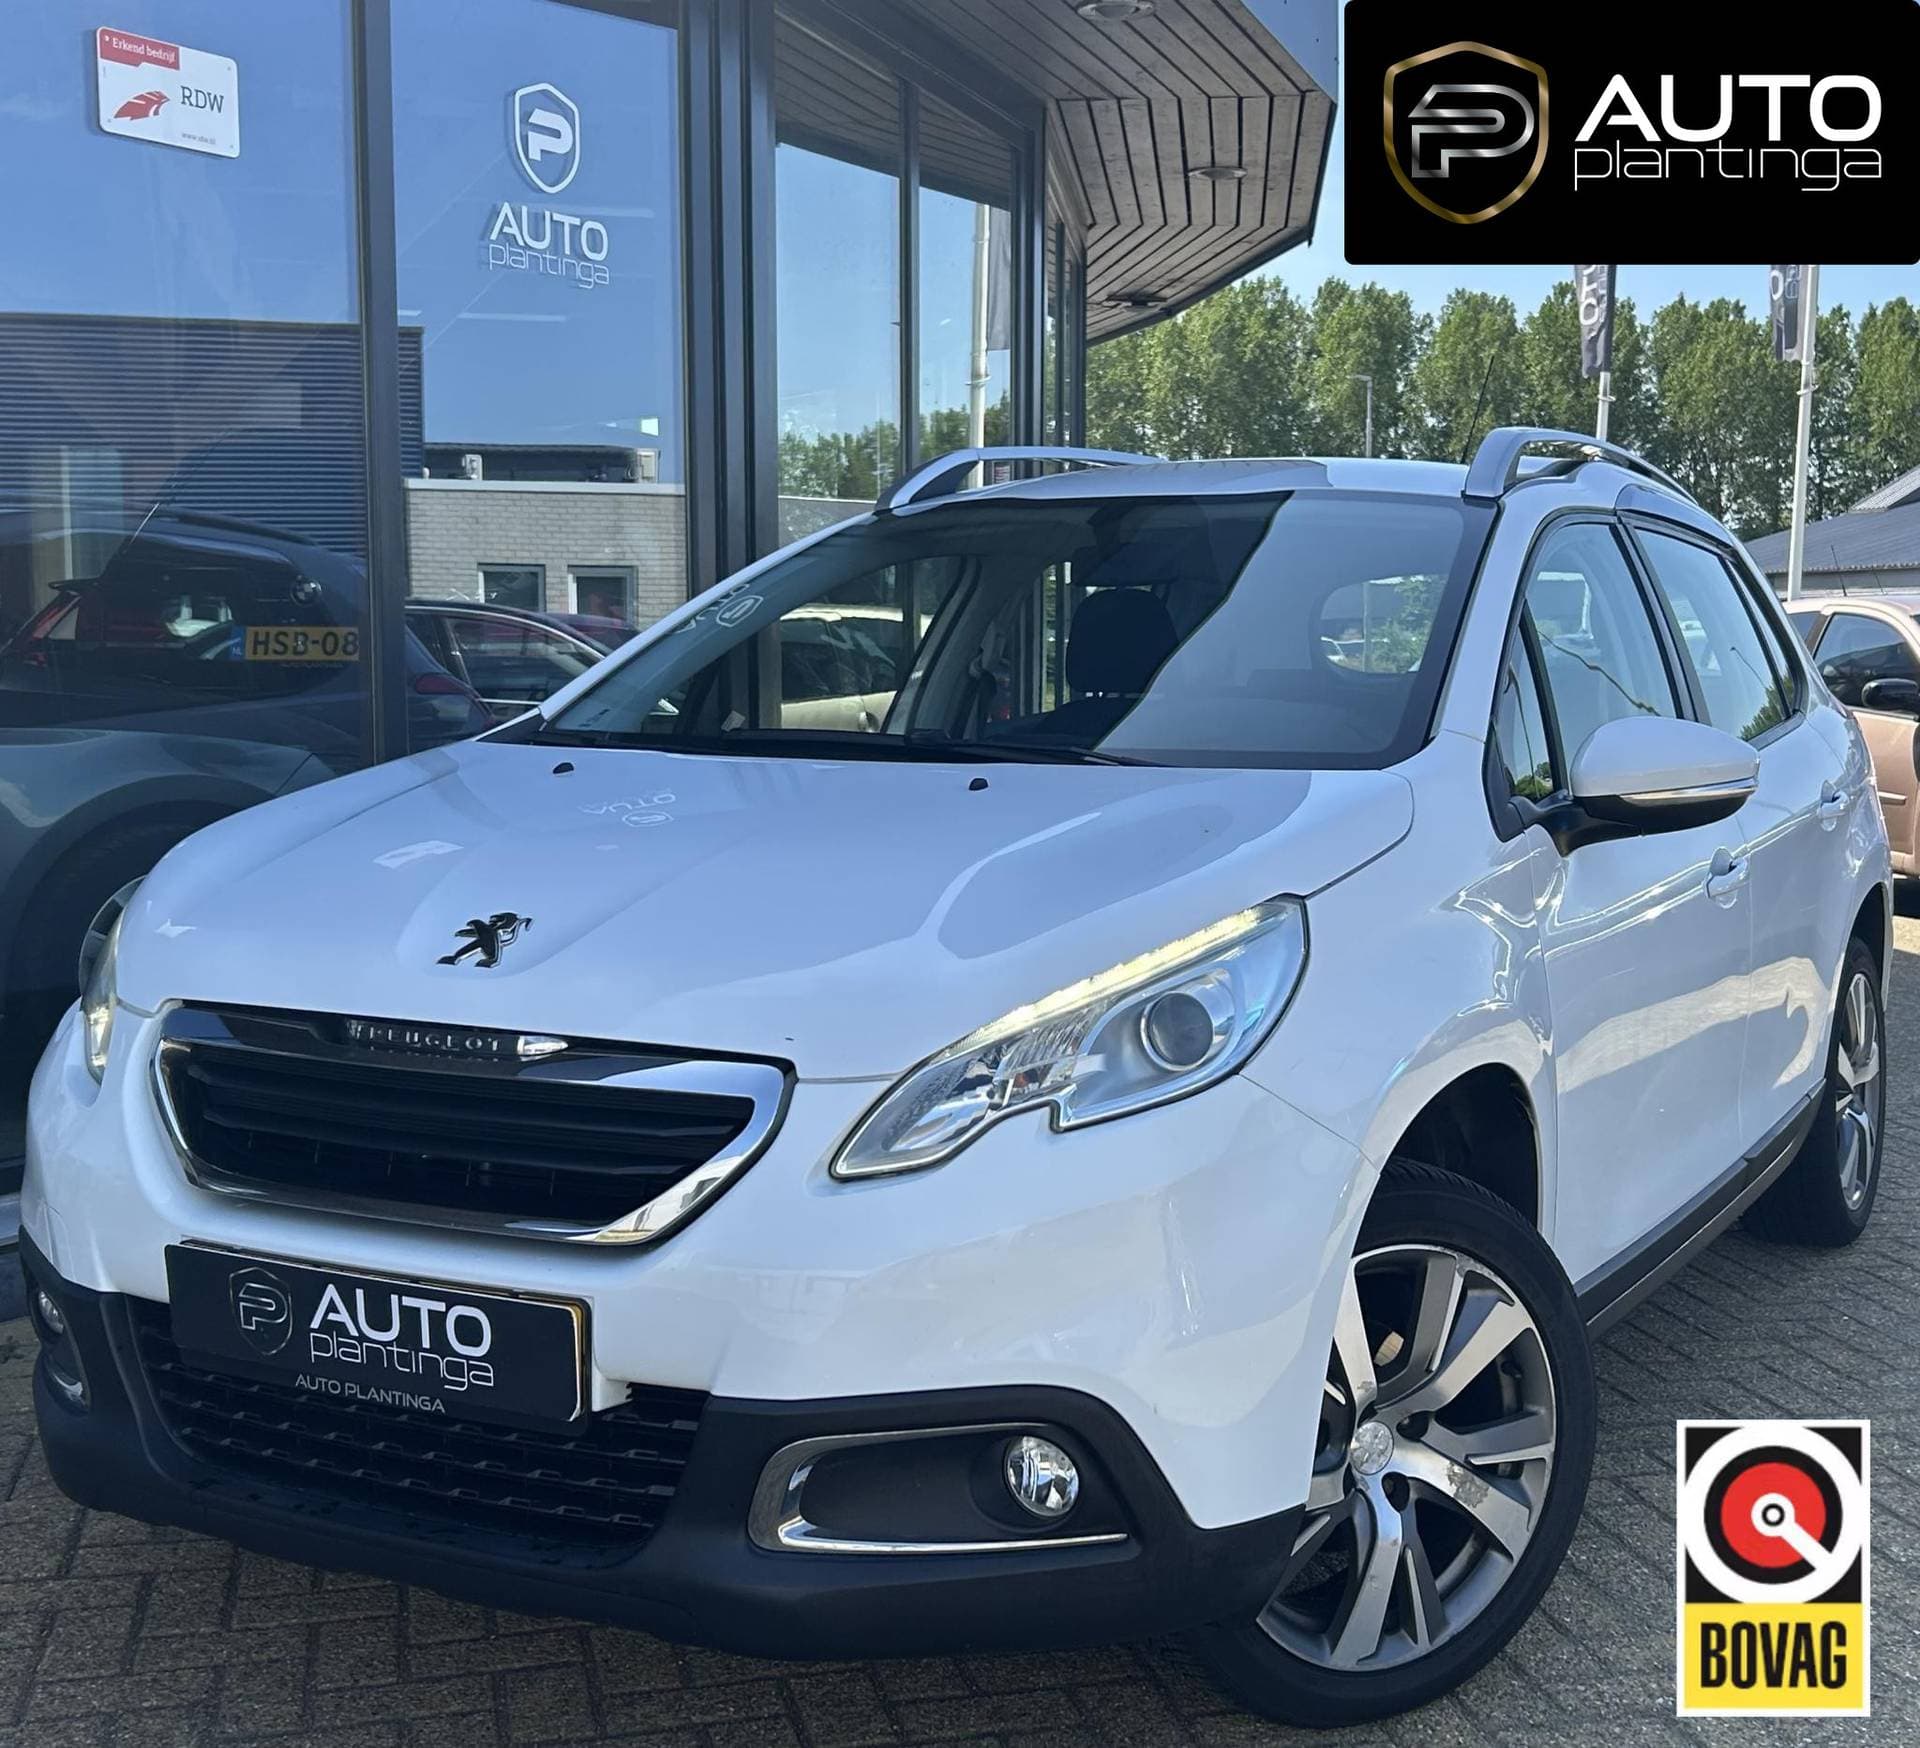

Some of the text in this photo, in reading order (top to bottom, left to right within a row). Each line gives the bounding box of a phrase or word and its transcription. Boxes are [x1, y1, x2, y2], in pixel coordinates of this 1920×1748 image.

[180, 85, 224, 114] RDW
[490, 202, 608, 261] AUTO
[489, 244, 610, 289] plantinga
[310, 1283, 493, 1357] AUTO
[310, 1331, 494, 1391] plantinga
[295, 1373, 446, 1414] AUTO PLANTINGA
